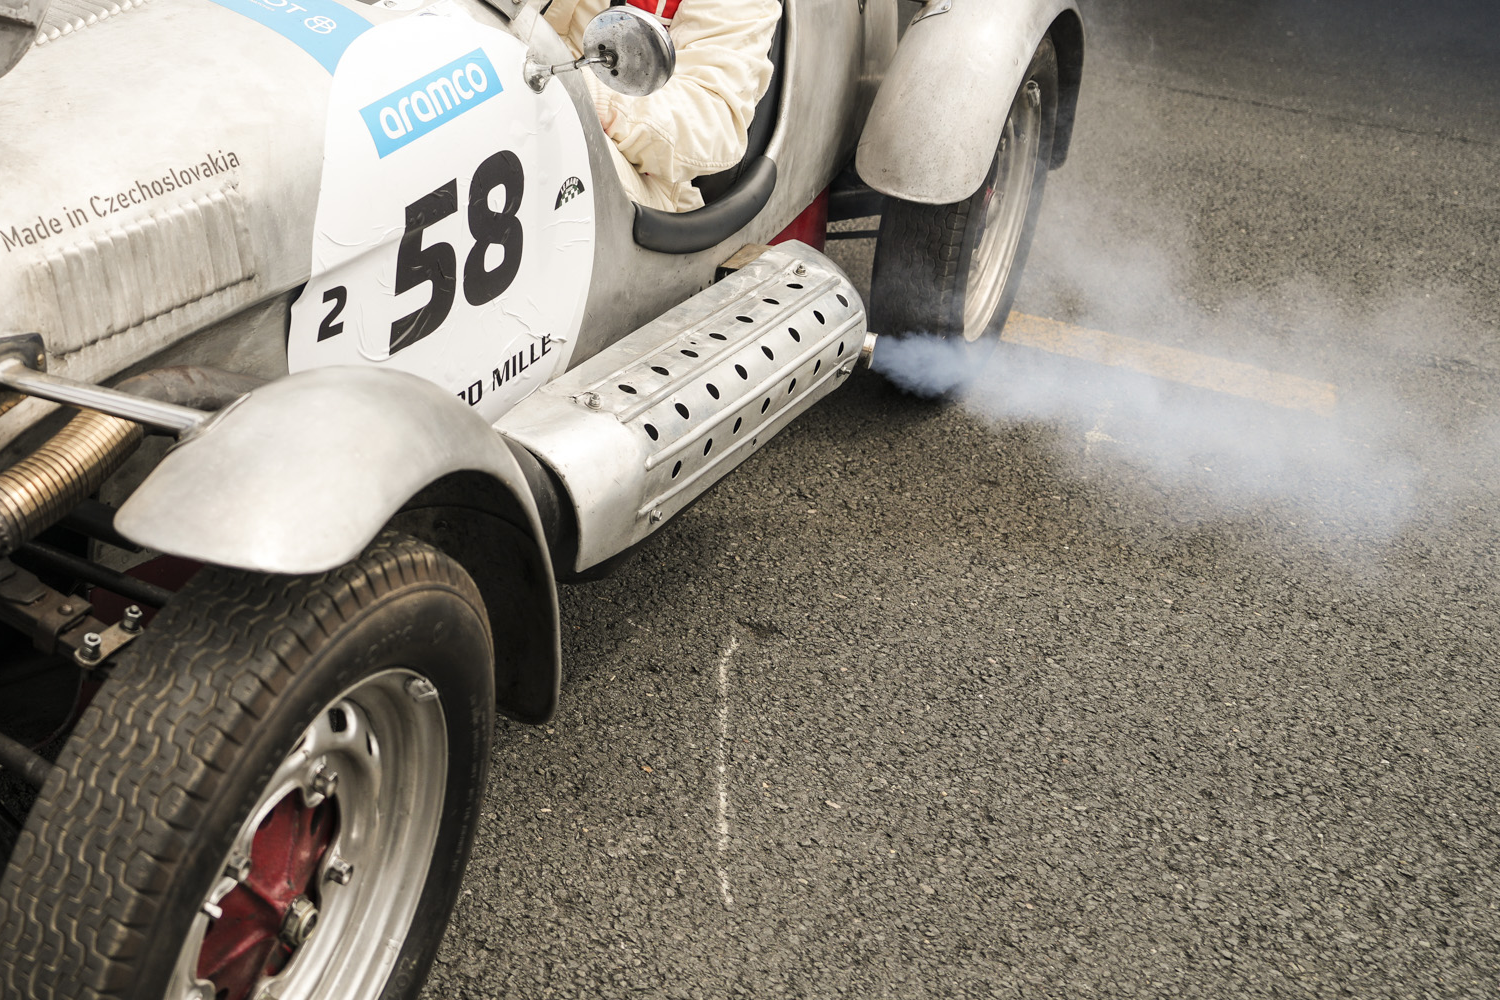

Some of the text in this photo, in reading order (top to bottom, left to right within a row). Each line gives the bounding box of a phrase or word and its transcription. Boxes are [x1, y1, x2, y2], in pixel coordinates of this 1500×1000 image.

[379, 62, 488, 140] aramco
[0, 150, 240, 252] Made in Czechoslovakia
[389, 149, 525, 357] 58
[316, 285, 347, 343] 2
[492, 333, 552, 392] MILLE
